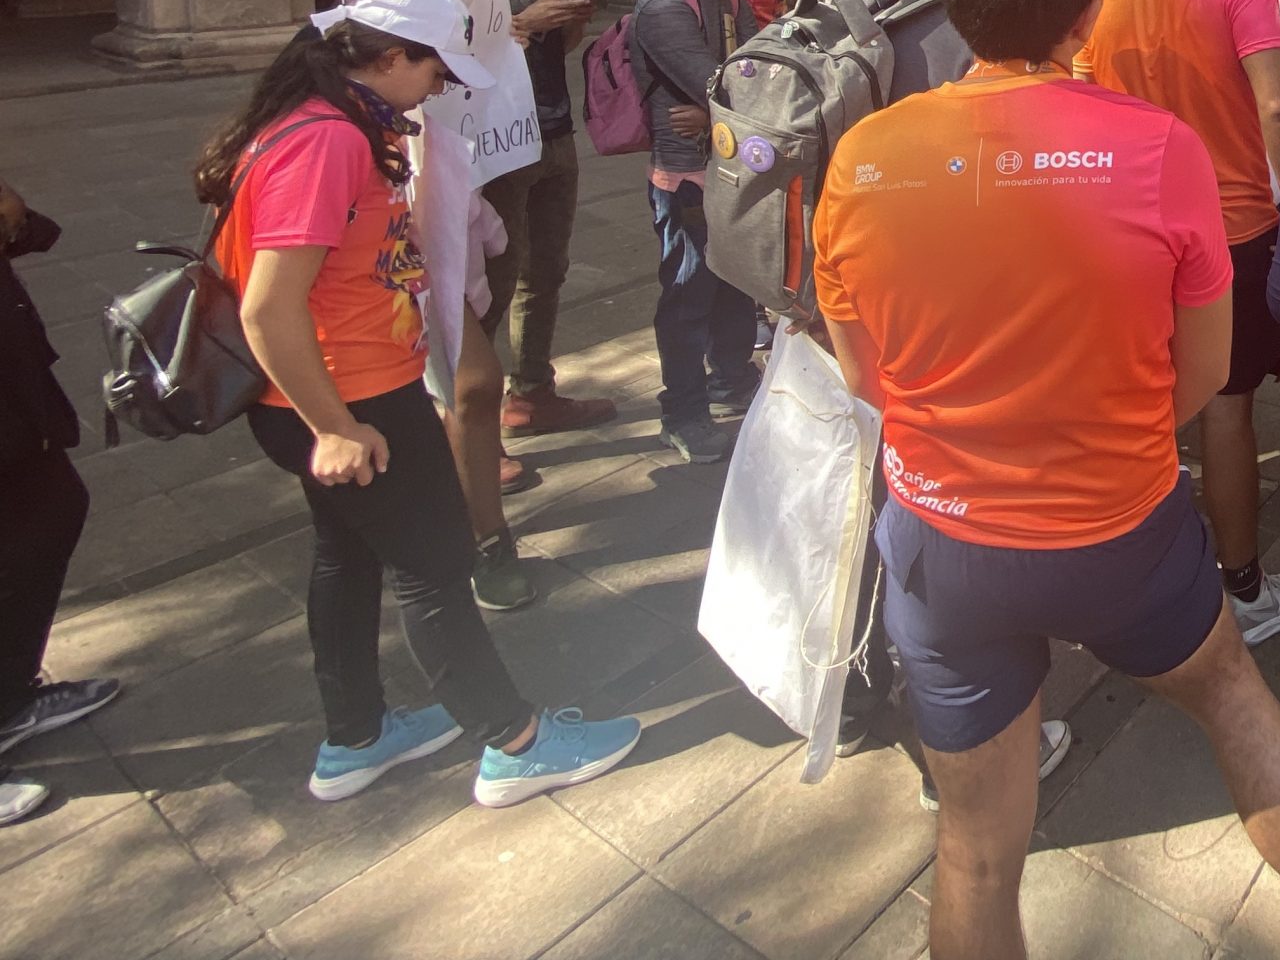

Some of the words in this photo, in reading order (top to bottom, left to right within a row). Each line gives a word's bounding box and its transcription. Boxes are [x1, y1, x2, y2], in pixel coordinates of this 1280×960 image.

[1034, 151, 1114, 169] BOSCH
[856, 162, 876, 176] BMW
[855, 171, 883, 185] GROUP
[995, 175, 1049, 188] Innovación
[1052, 175, 1075, 185] para
[1078, 175, 1089, 183] tu
[1091, 174, 1112, 184] vida
